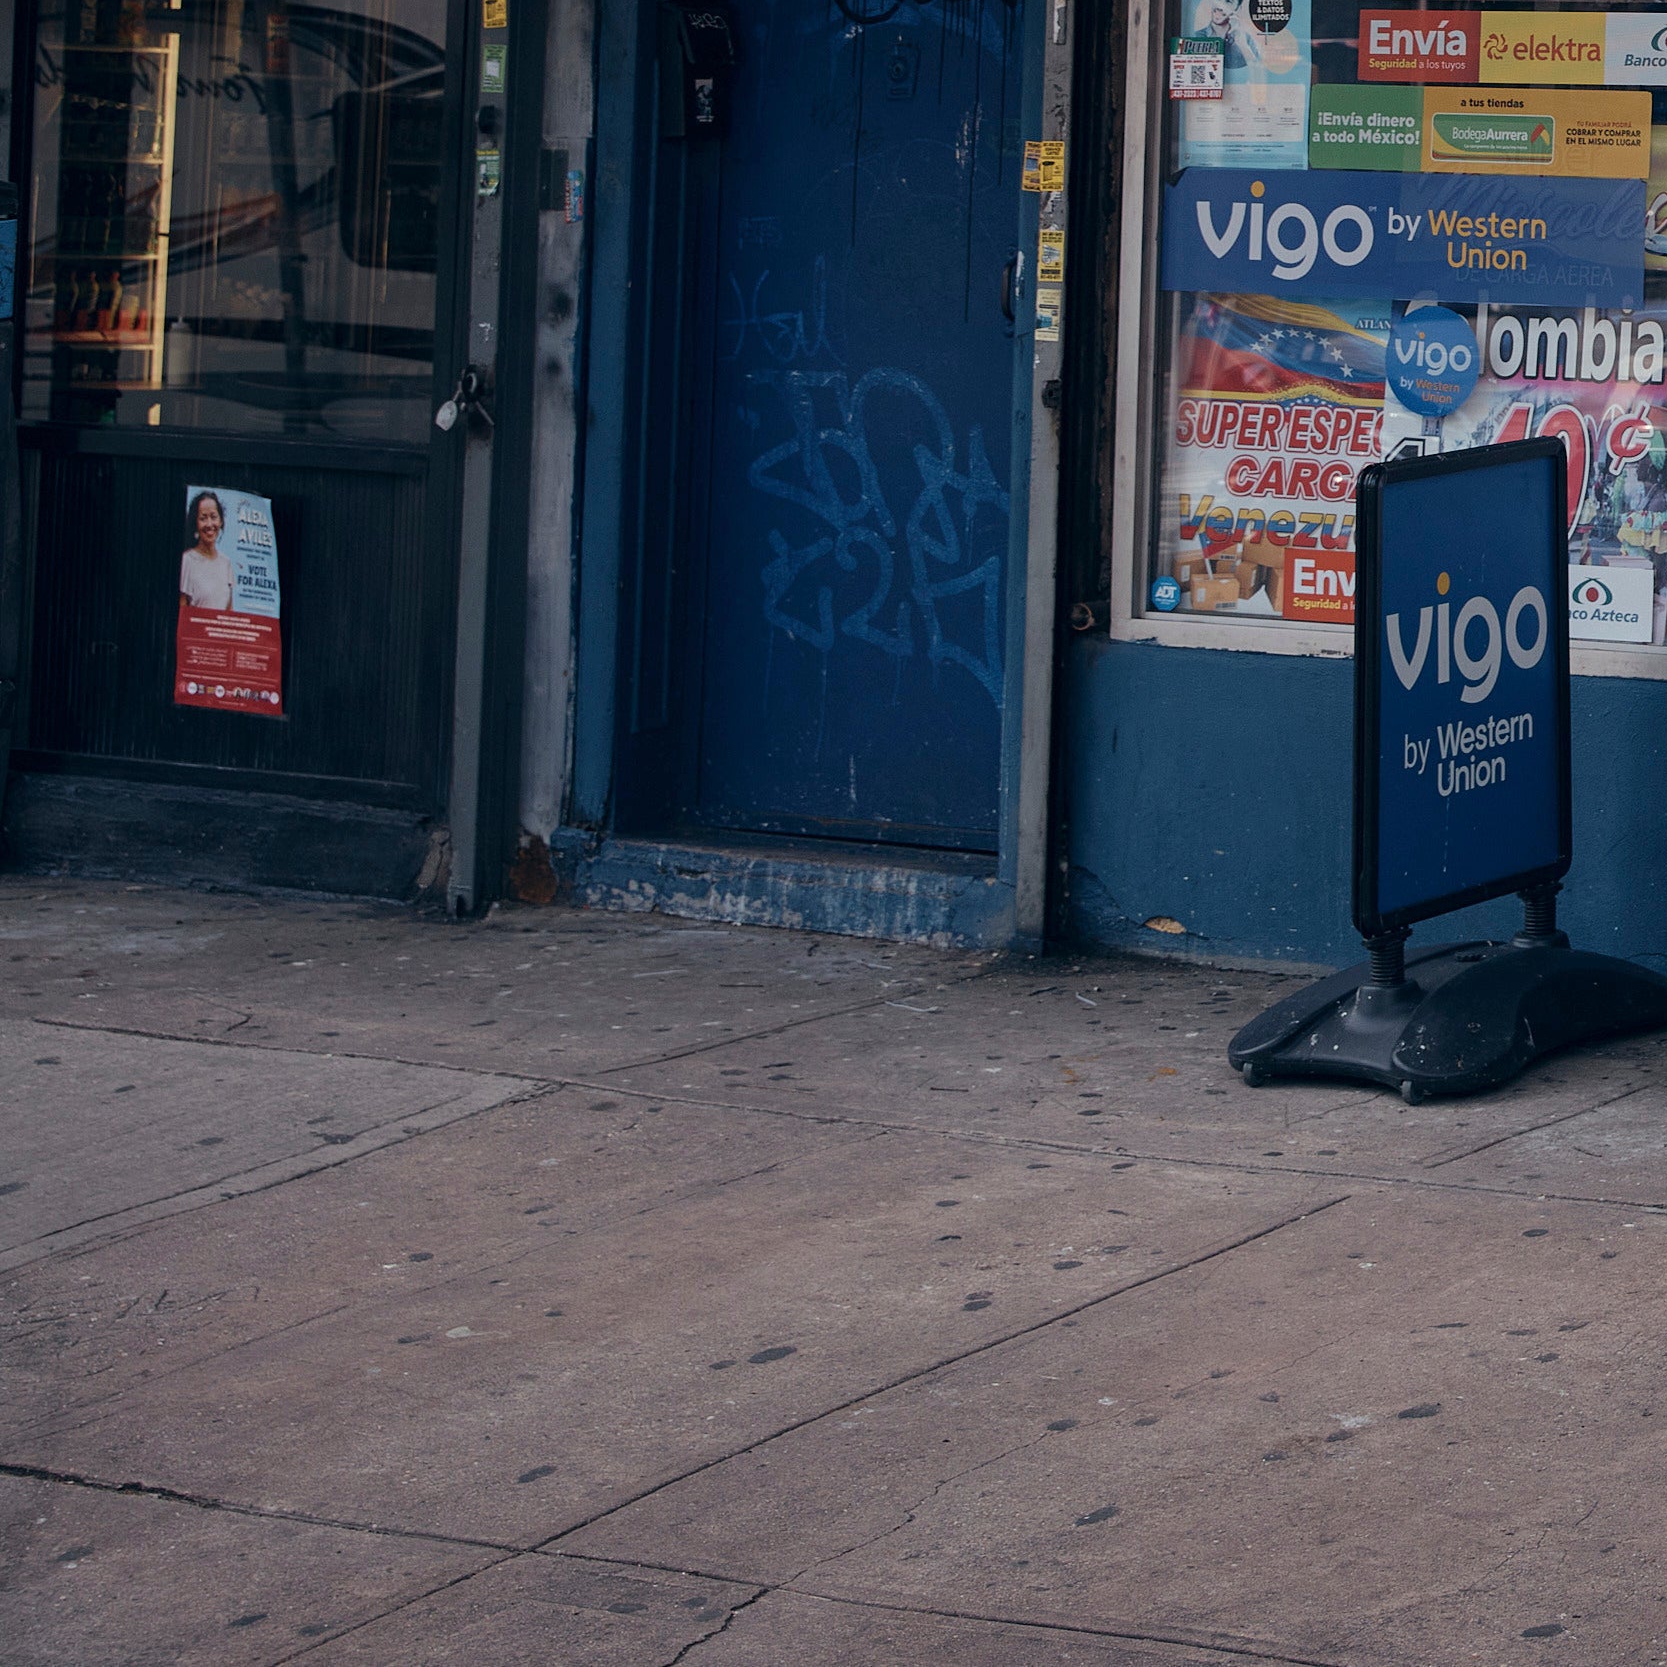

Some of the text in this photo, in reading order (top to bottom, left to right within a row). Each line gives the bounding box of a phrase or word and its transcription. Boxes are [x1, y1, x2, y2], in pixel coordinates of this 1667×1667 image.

[1369, 19, 1466, 56] Envía
[1513, 34, 1600, 62] elektra
[1623, 53, 1667, 69] Banco
[1312, 128, 1421, 146] a todo México!
[1197, 180, 1547, 281] vigo by Western
[1447, 241, 1527, 272] Union
[1386, 571, 1548, 704] vigo
[1404, 713, 1533, 775] by Western
[1437, 756, 1505, 797] Union
